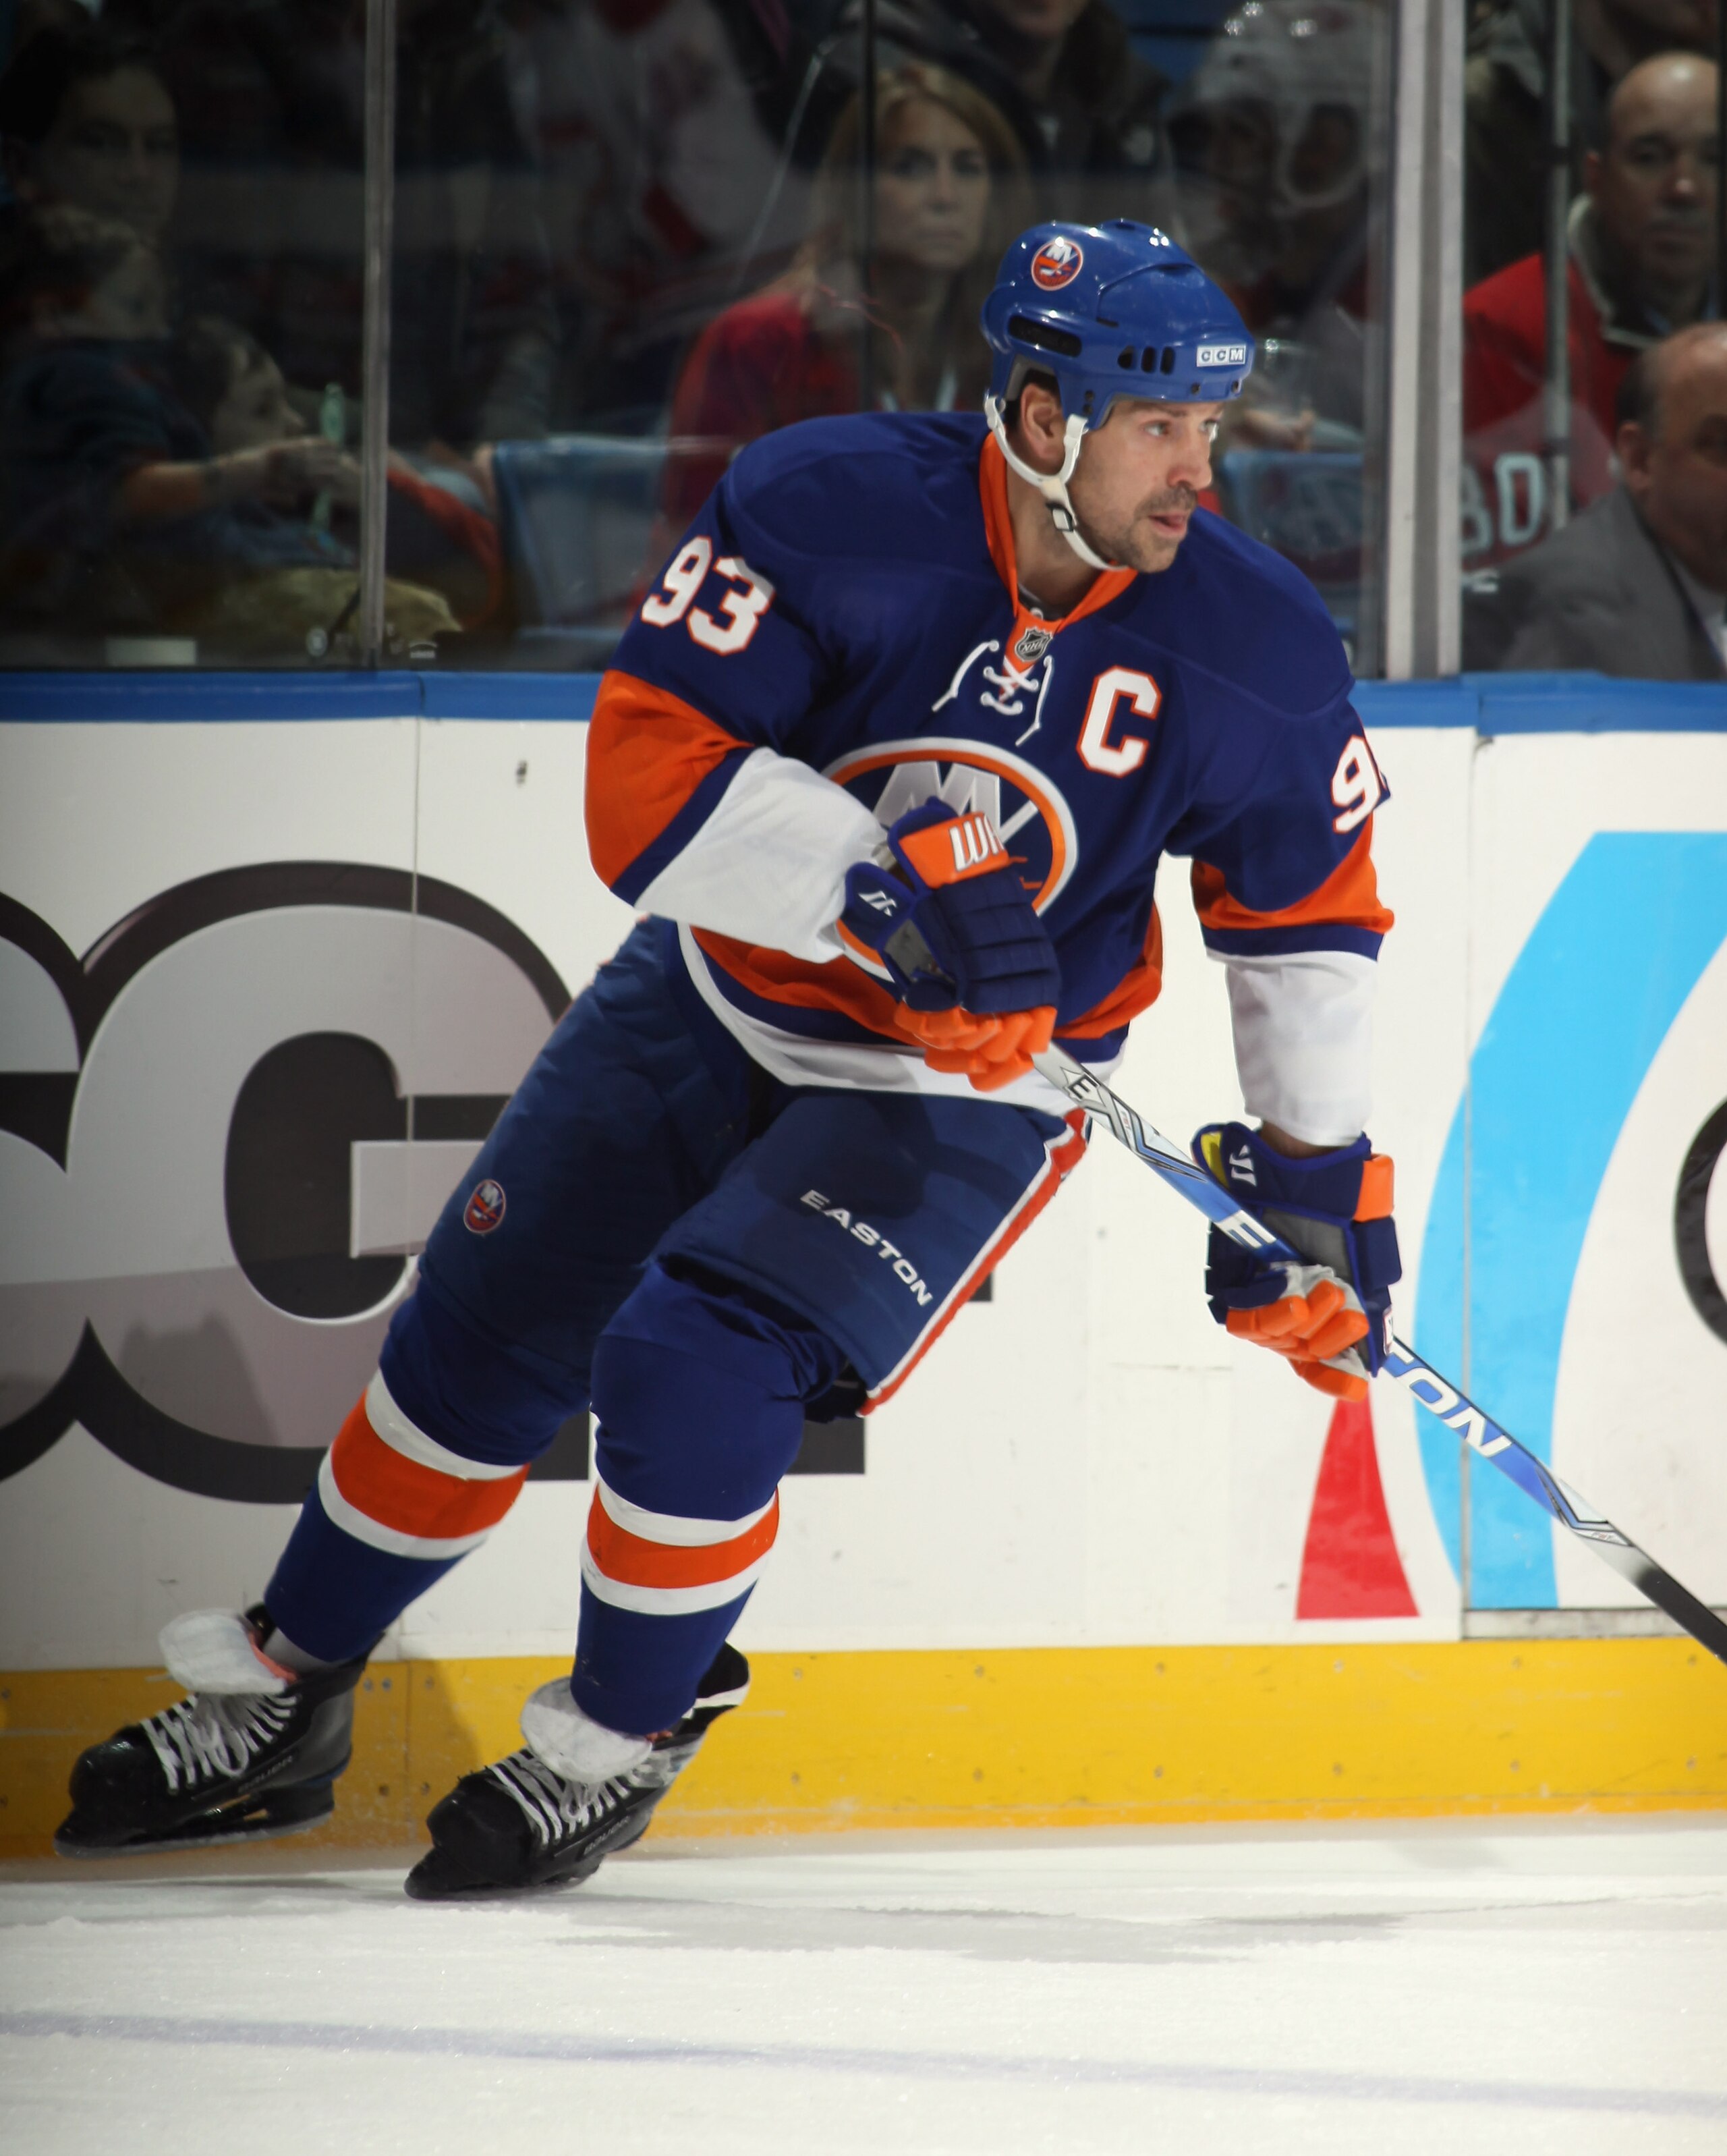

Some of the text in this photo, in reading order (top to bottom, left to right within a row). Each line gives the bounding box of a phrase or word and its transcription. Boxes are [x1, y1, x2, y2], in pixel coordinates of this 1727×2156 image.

[1201, 347, 1245, 363] CCM
[641, 535, 776, 657] 93
[1076, 665, 1162, 778] C
[1331, 734, 1388, 834] 9
[799, 1189, 933, 1306] EASTON
